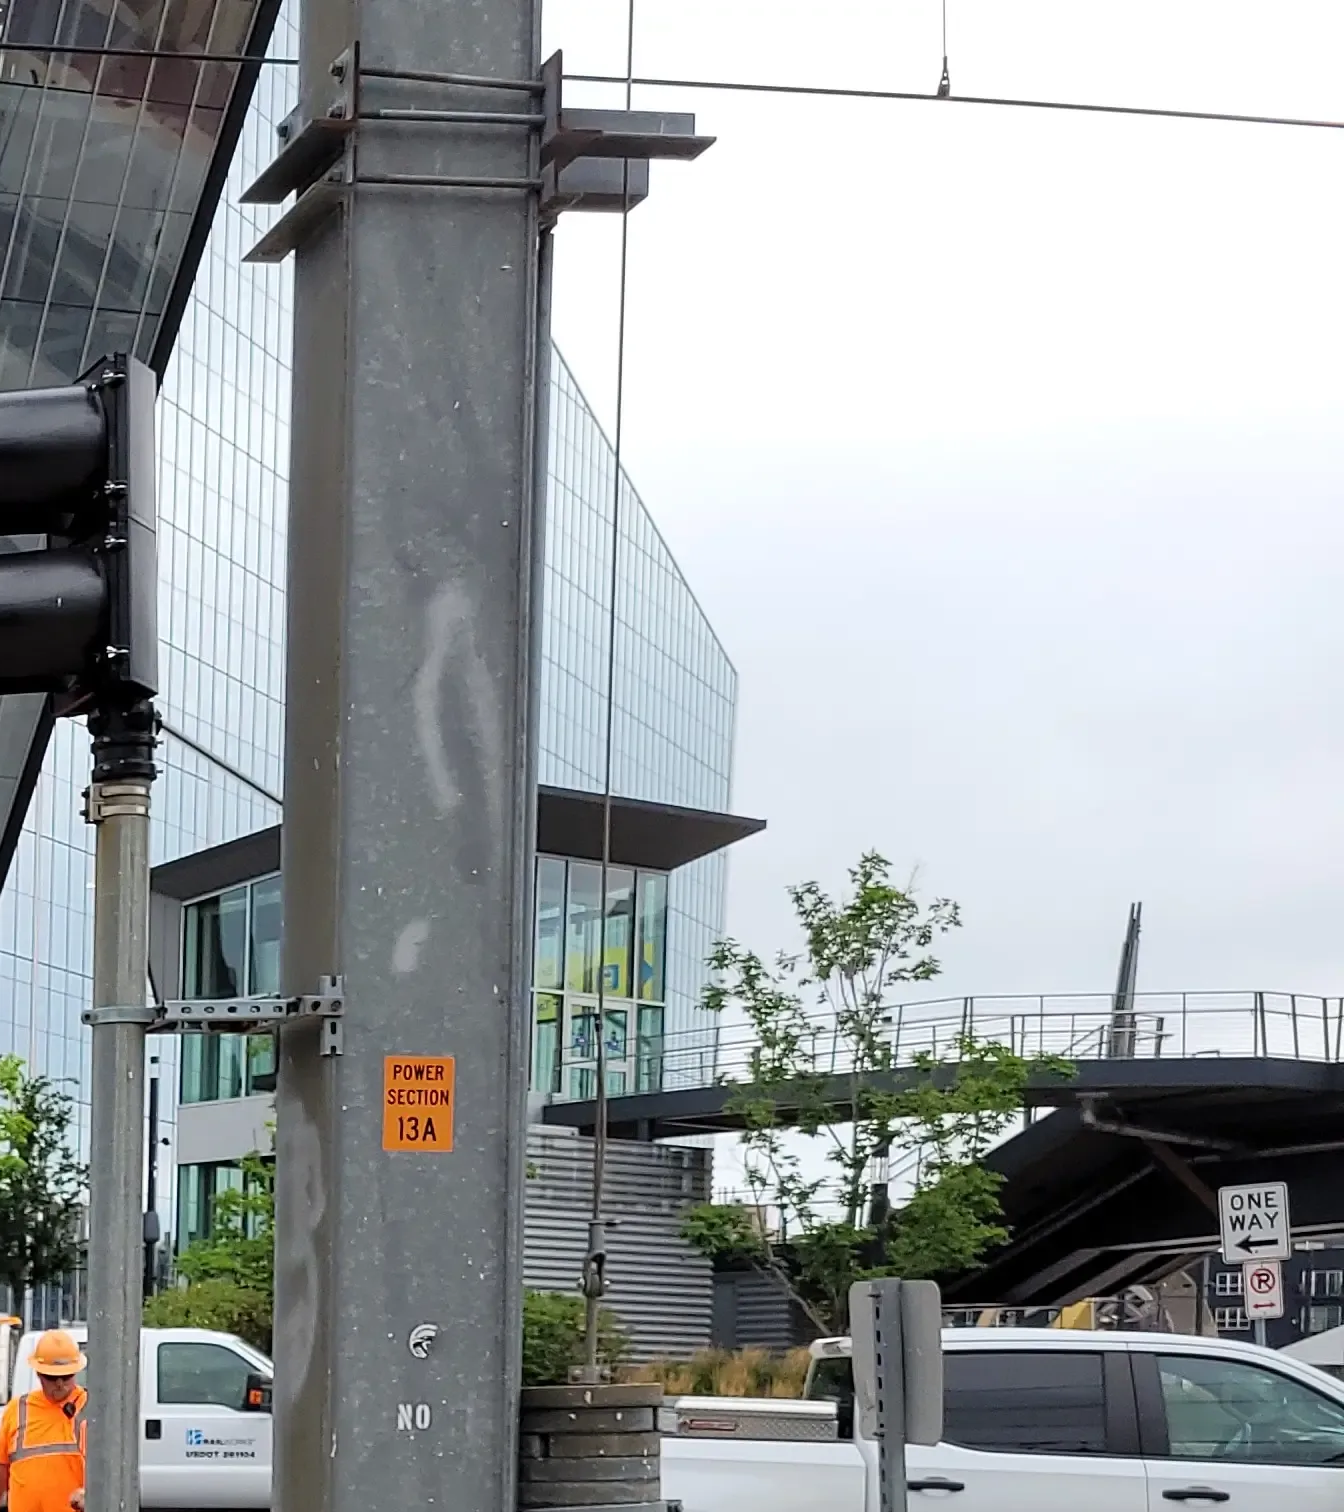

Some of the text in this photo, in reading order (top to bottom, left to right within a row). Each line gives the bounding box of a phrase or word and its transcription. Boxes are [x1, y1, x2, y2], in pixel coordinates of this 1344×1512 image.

[393, 1064, 444, 1081] POWER
[387, 1089, 450, 1106] SECTION
[398, 1116, 437, 1142] 13A
[1230, 1191, 1279, 1211] ONE
[1229, 1212, 1279, 1232] WAY
[397, 1403, 431, 1431] NO
